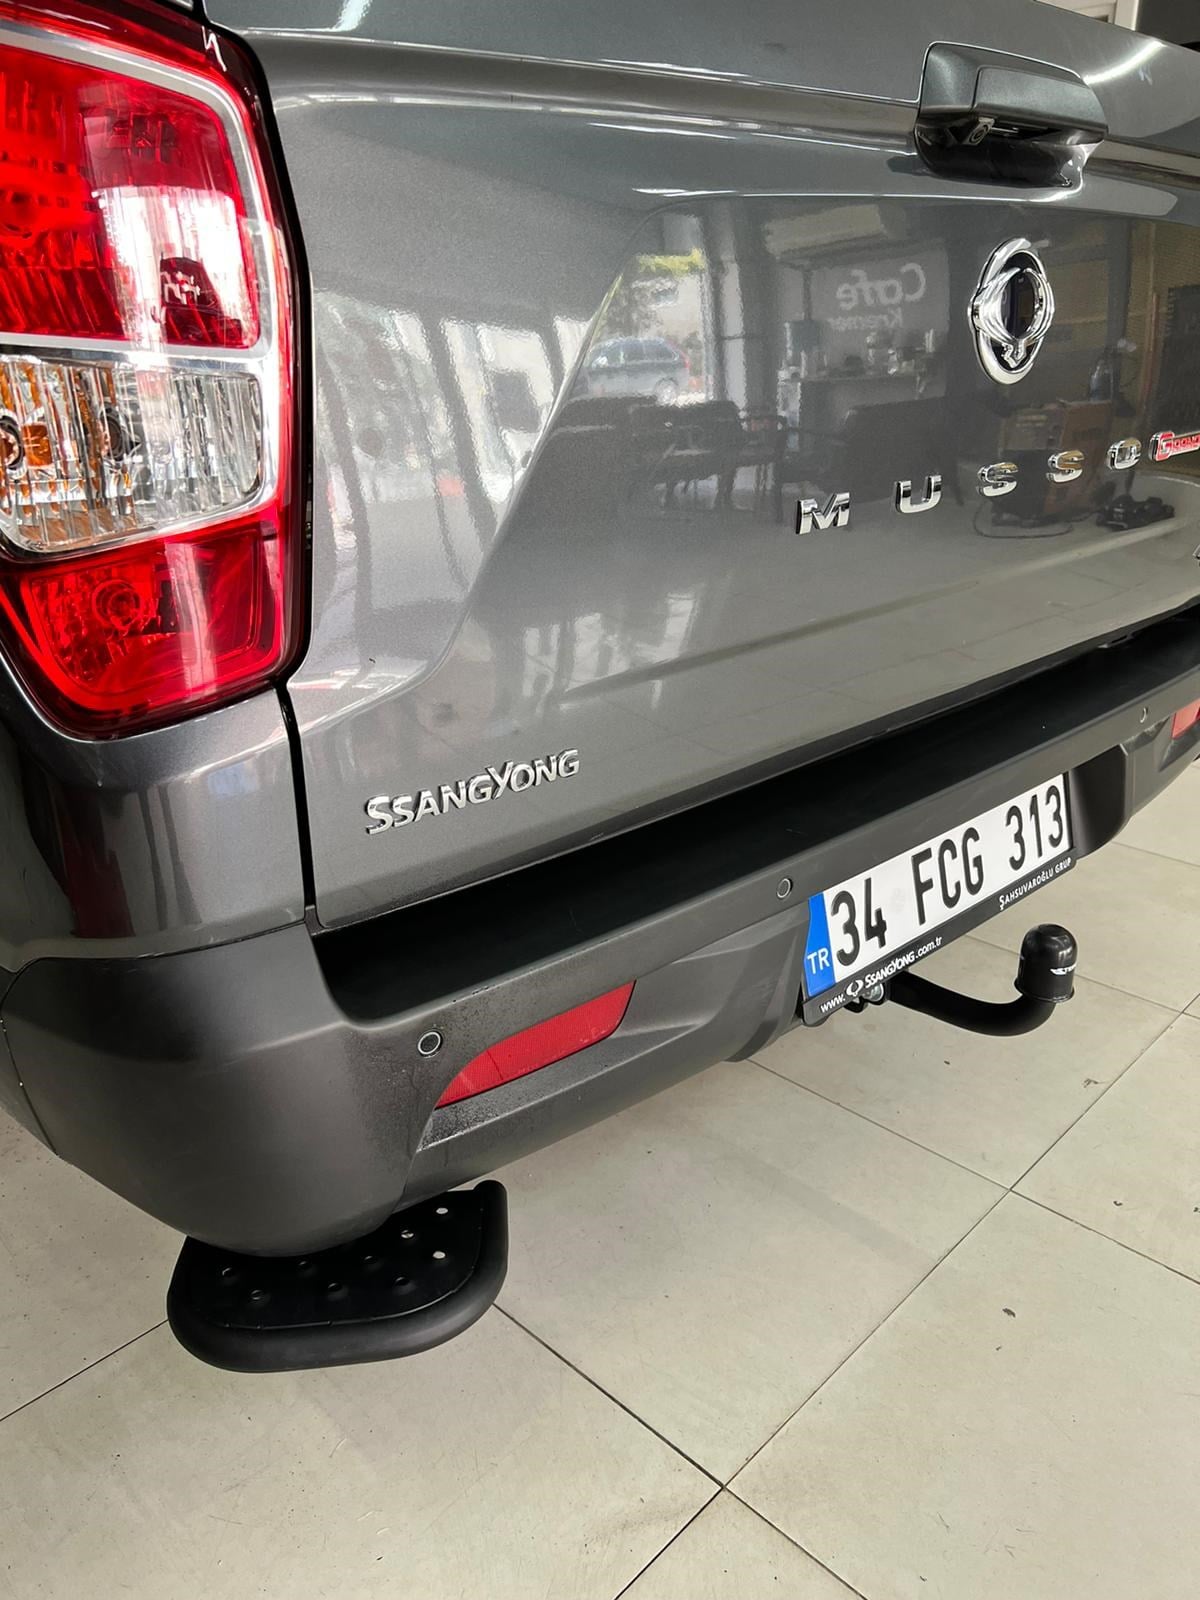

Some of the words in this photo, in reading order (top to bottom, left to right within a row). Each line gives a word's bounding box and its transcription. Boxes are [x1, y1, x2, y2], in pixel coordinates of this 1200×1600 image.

[796, 437, 1142, 534] MUSSO
[830, 877, 887, 966] 34
[911, 827, 985, 926] FCG
[1005, 785, 1064, 871] 313
[1054, 857, 1072, 874] GRUP
[807, 947, 831, 975] TR
